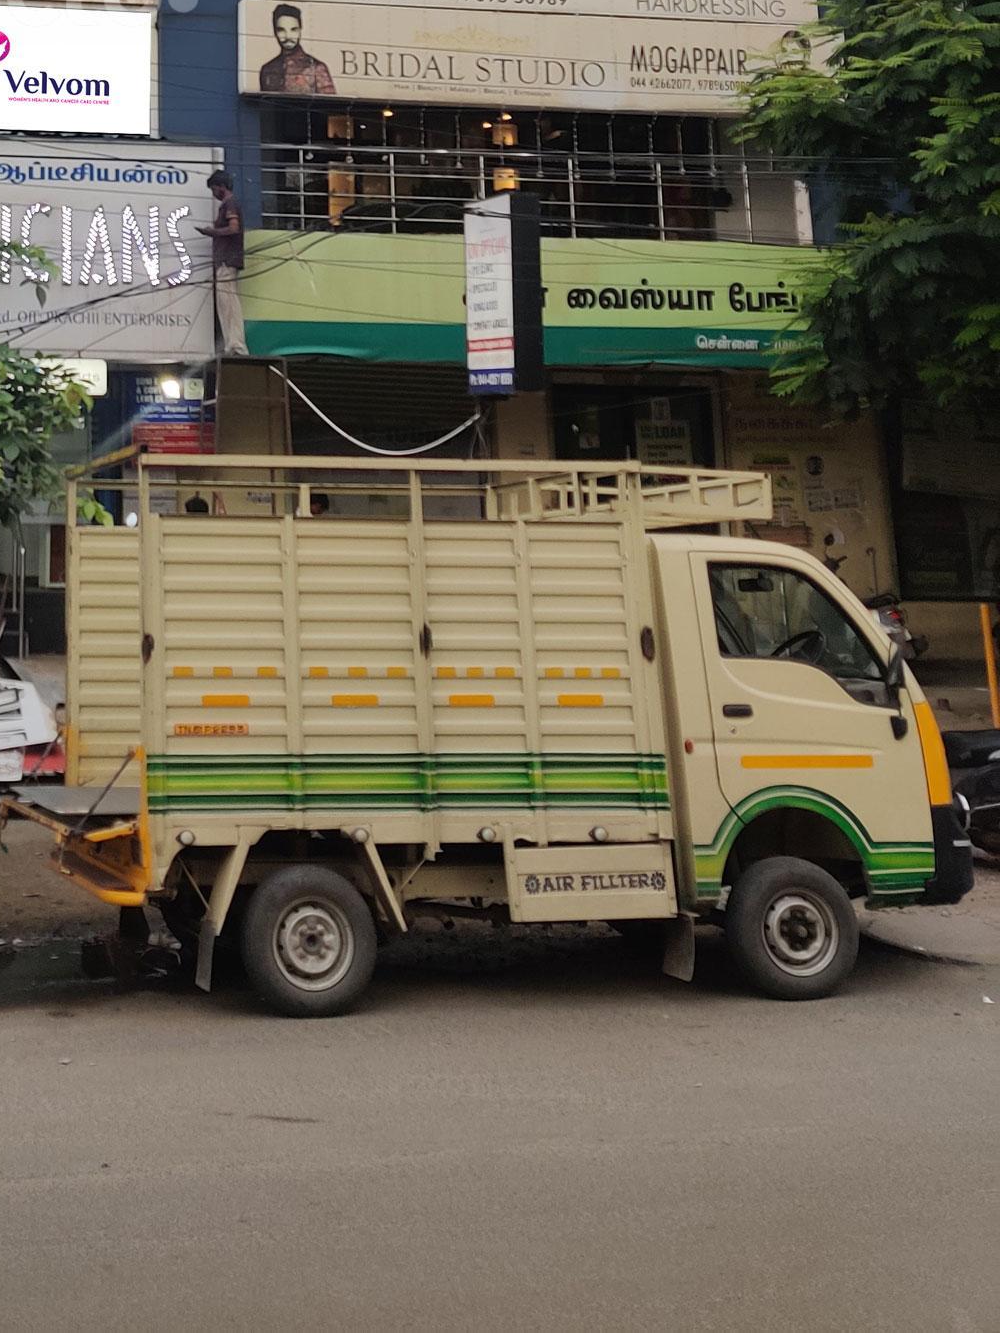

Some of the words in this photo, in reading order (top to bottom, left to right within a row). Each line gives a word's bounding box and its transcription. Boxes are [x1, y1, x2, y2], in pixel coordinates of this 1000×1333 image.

[341, 50, 465, 81] BRIDAL
[475, 56, 605, 87] STUDIO
[630, 45, 748, 76] MOGAPPAIR
[3, 69, 110, 96] Velvom
[630, 76, 647, 88] 044
[567, 278, 715, 311] வைஸ்யா
[728, 281, 799, 313] பேங்
[104, 312, 192, 327] ENTERPRISES
[696, 334, 759, 351] சென்னை
[542, 876, 574, 893] AIR
[580, 873, 650, 891] FILLTER
